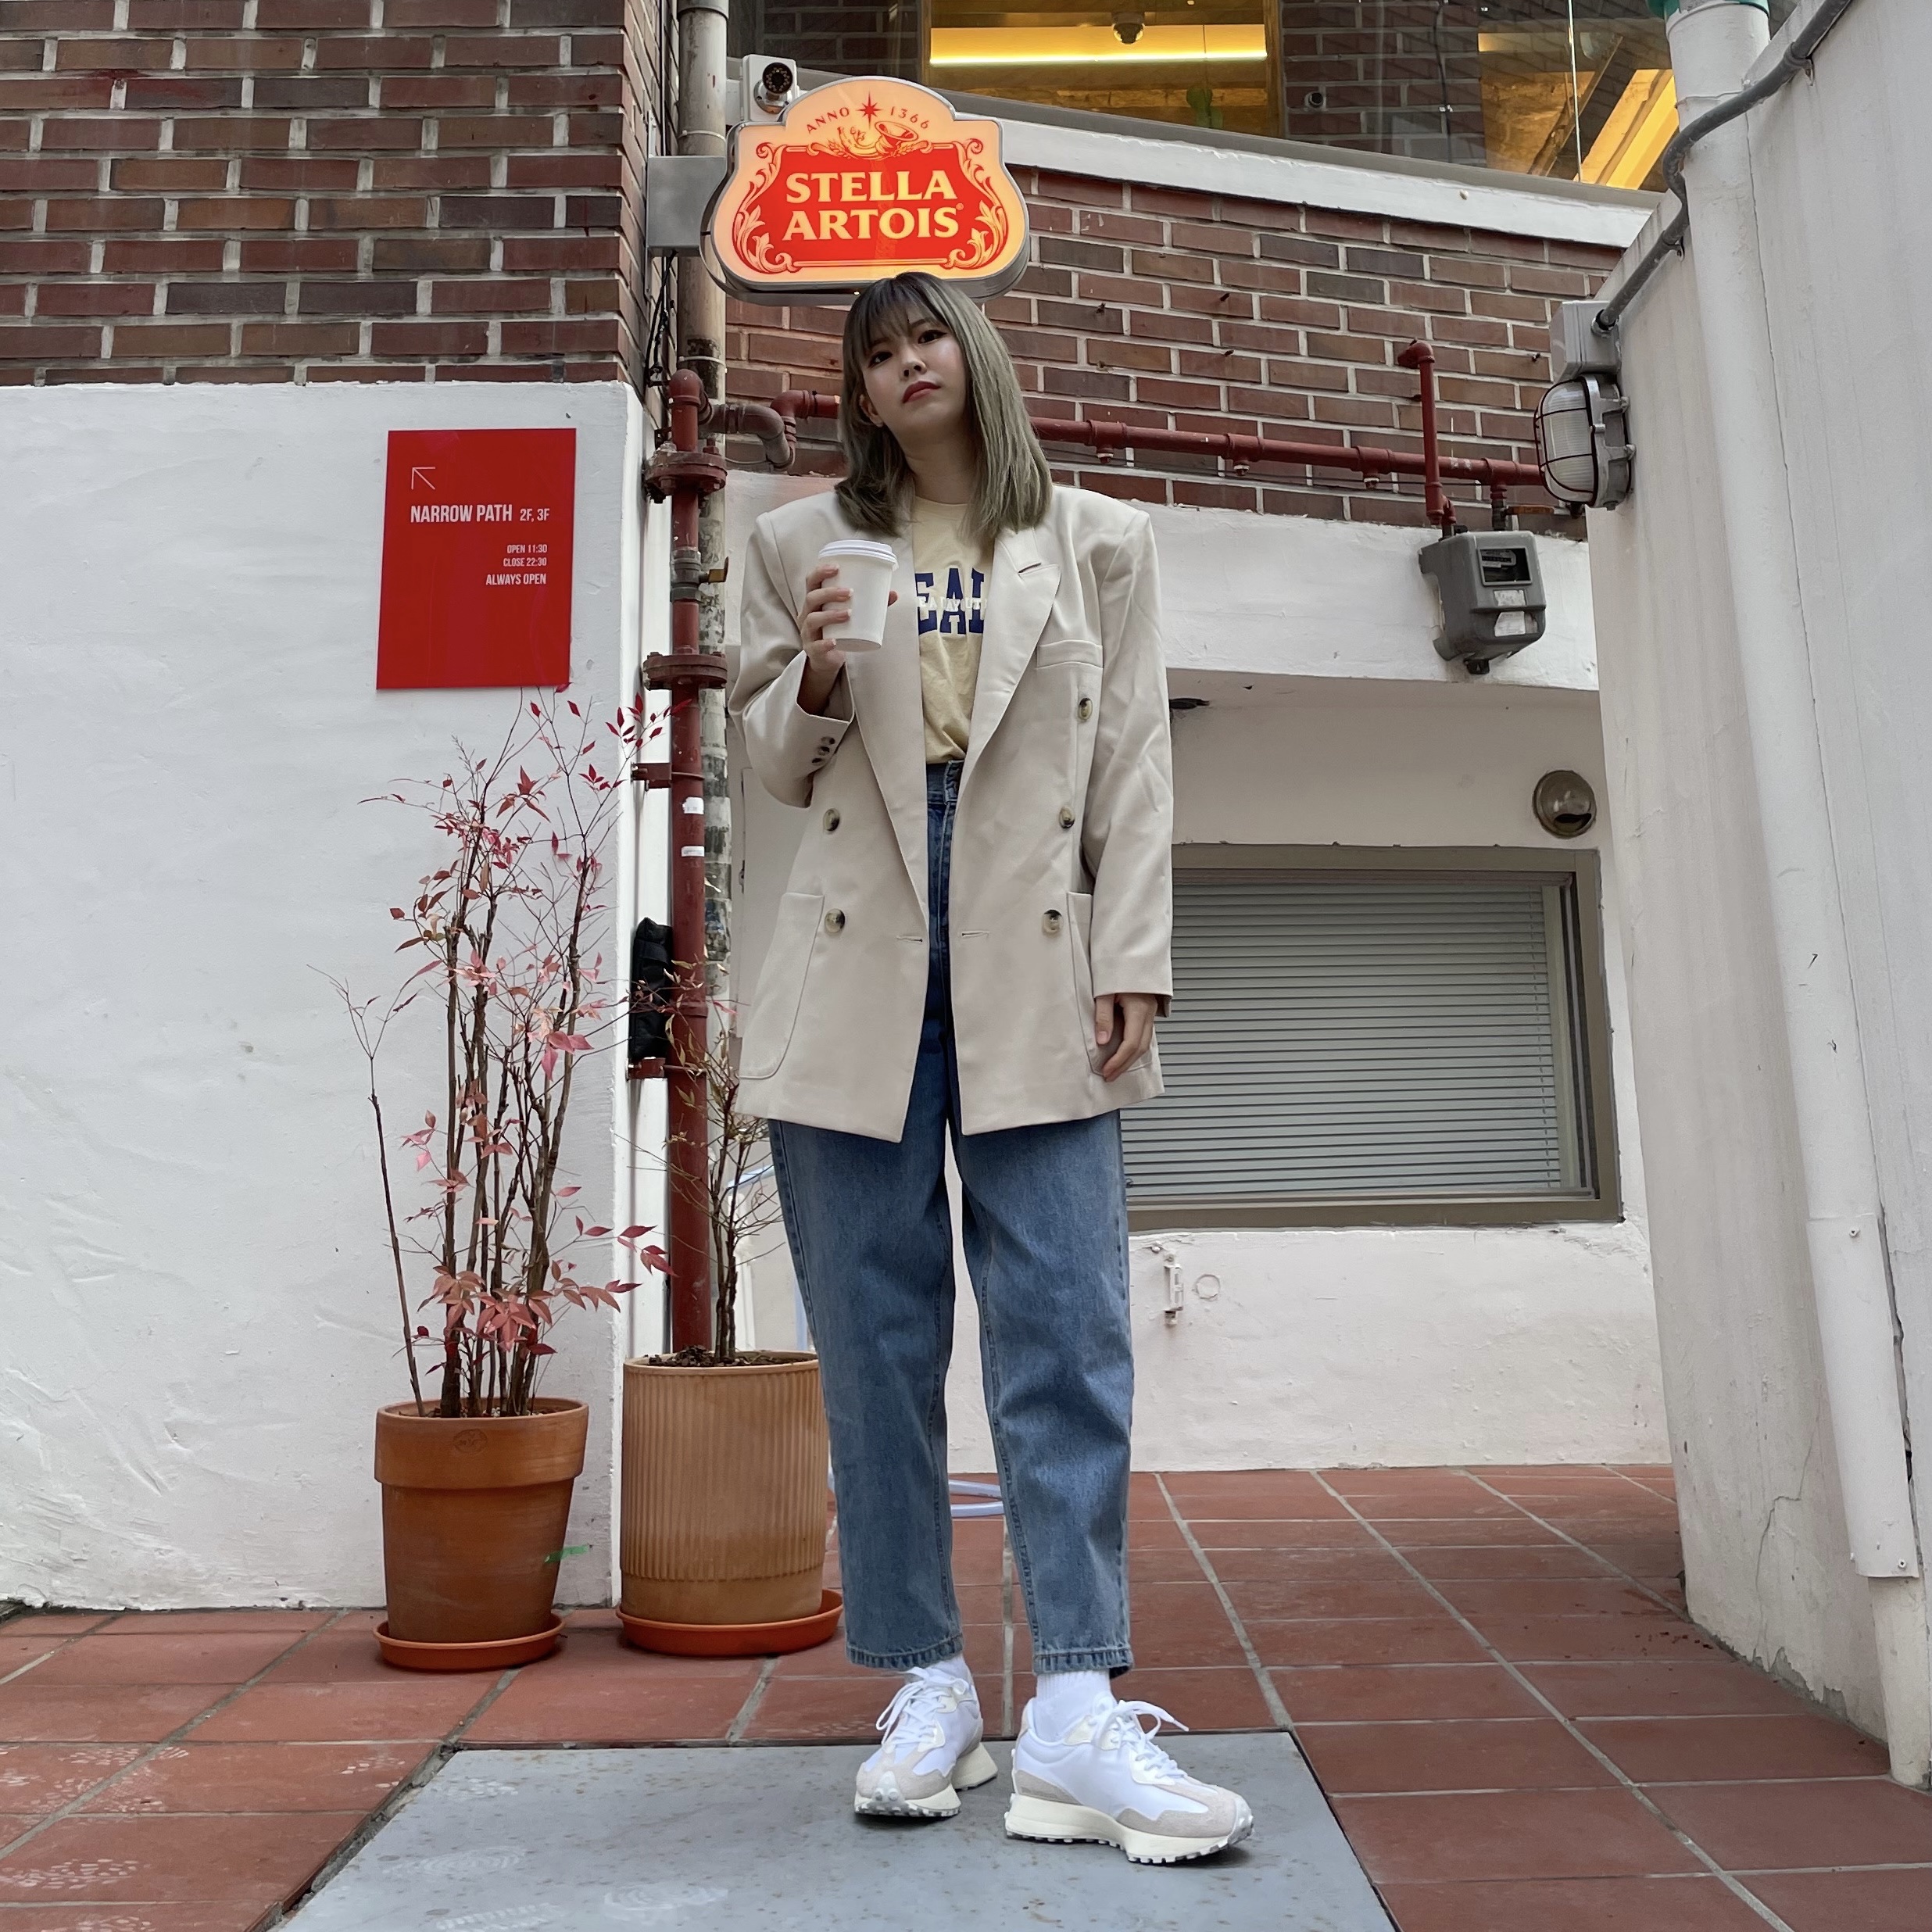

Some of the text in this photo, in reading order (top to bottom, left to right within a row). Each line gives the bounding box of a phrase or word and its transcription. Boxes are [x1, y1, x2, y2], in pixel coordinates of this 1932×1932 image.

[807, 106, 930, 134] ANNO 1366
[785, 170, 958, 203] STELLA
[782, 207, 960, 241] ARTOIS
[410, 504, 550, 523] NARROW PATH 2F, 3F
[507, 544, 548, 554] OPEN 11:30
[503, 557, 547, 567] CLOSE 22:30
[486, 573, 546, 586] ALWAYS OPEN
